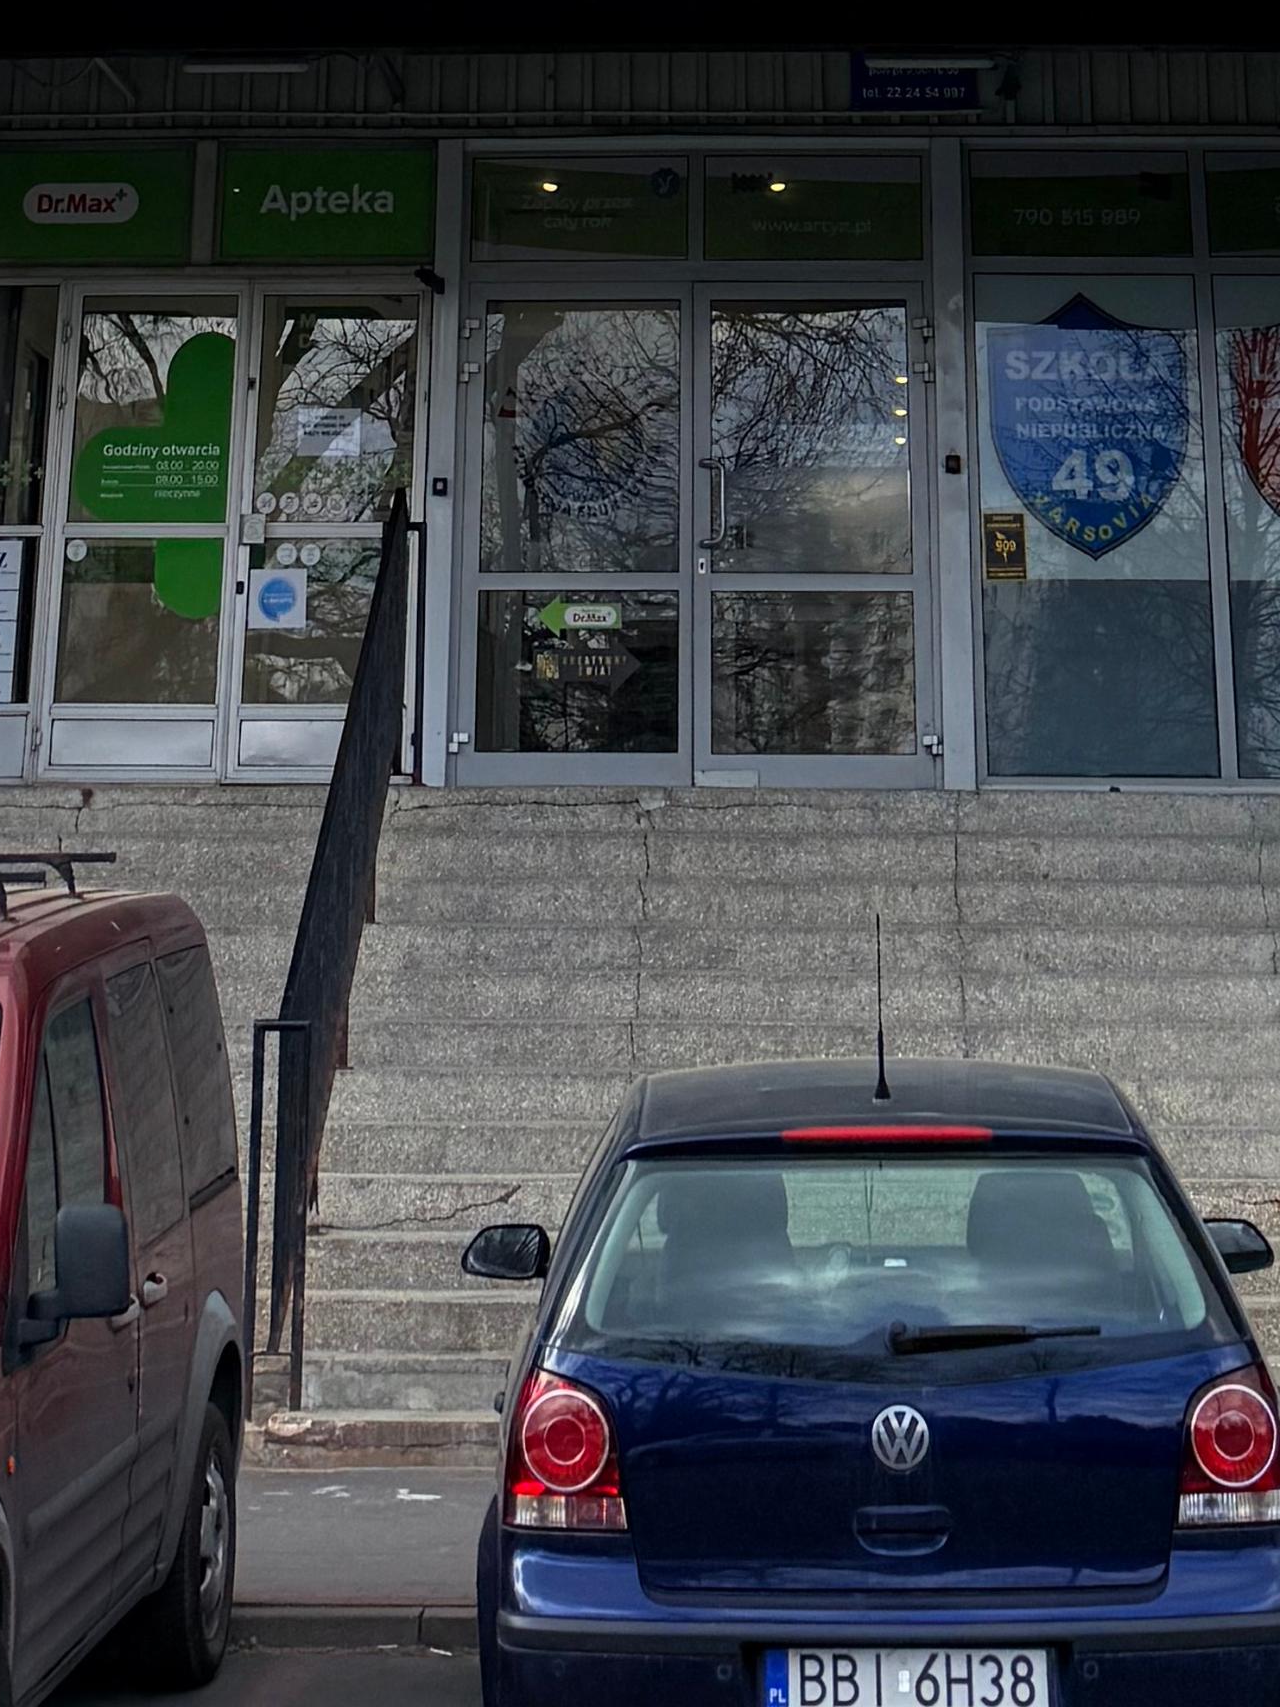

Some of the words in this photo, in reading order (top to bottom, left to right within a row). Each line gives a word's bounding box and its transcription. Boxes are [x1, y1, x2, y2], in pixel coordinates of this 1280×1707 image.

[37, 193, 115, 213] Dr.Max
[259, 182, 394, 221] Apteka
[103, 444, 159, 459] Godziny
[162, 443, 220, 457] otwarcia
[1052, 449, 1137, 501] 49
[915, 1652, 1035, 1707] 6H38
[770, 1688, 787, 1704] PL
